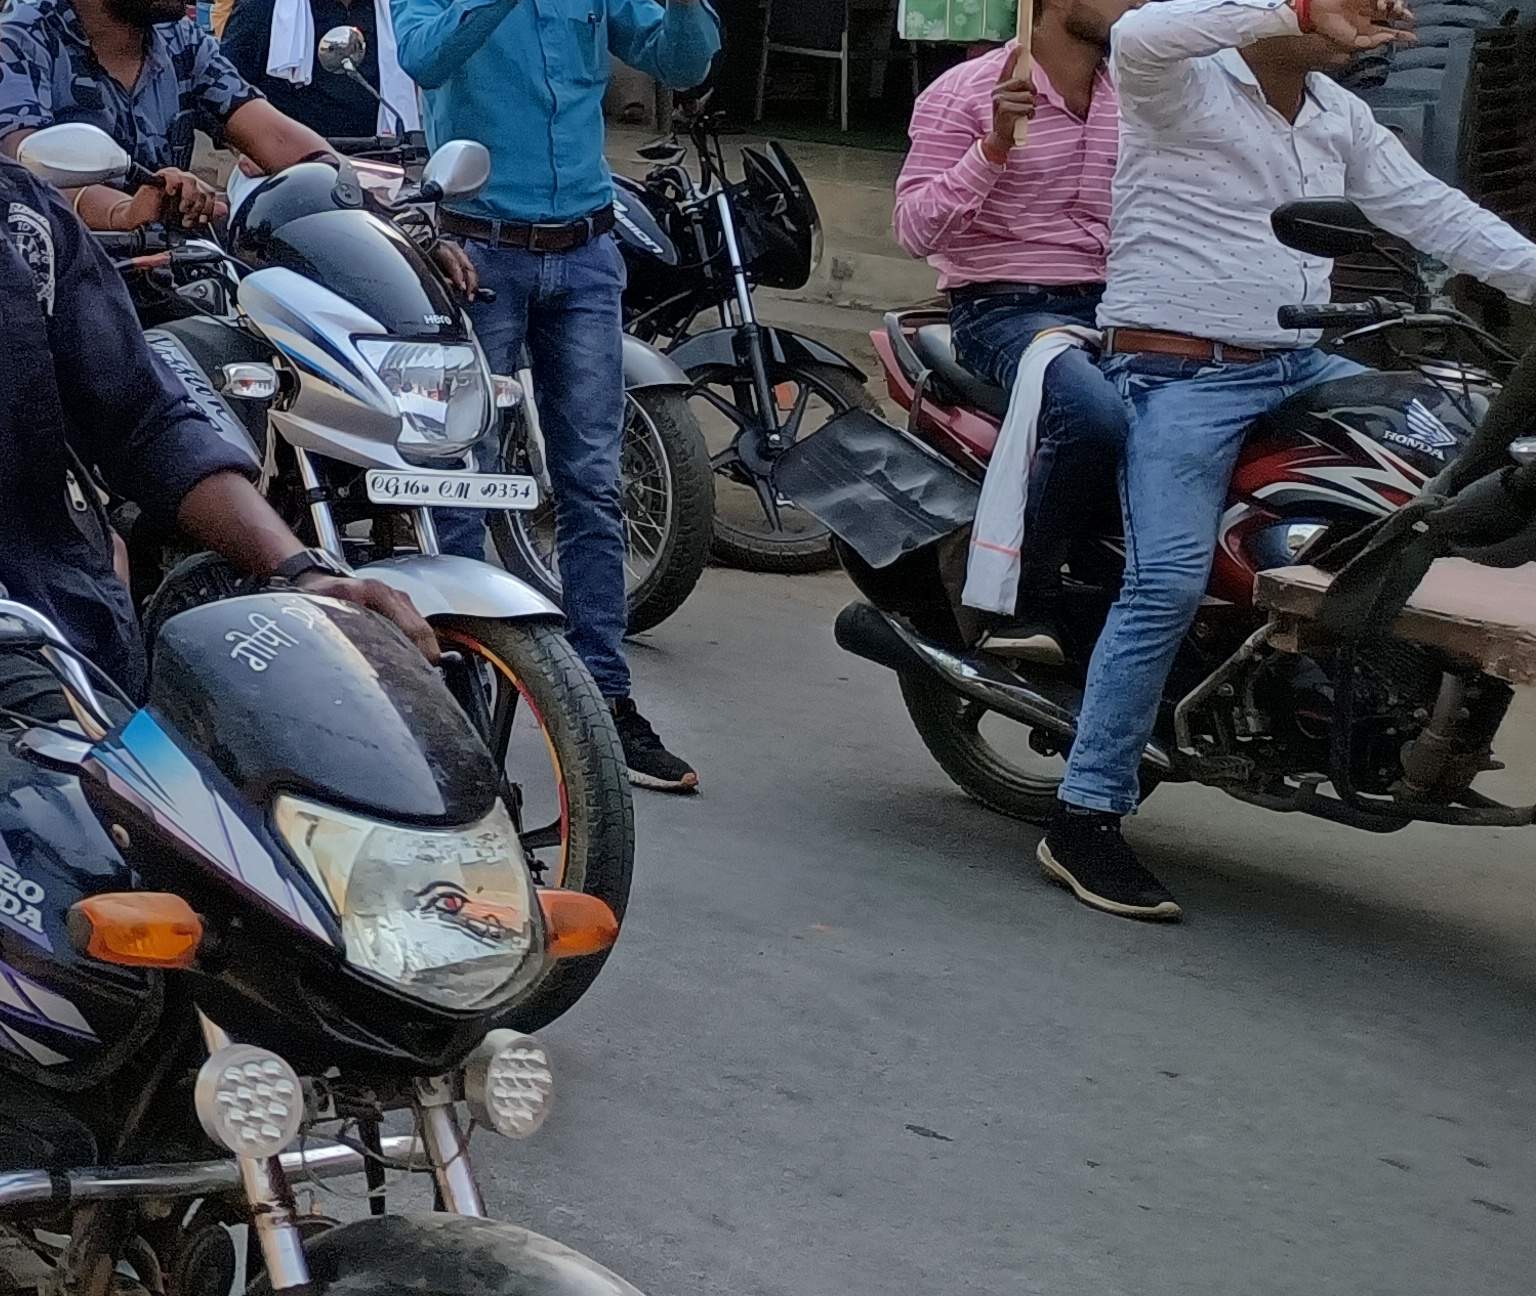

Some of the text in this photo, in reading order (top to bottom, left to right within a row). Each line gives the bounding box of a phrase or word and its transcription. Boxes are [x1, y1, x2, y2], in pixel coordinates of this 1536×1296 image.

[424, 312, 453, 326] Hero
[1383, 430, 1446, 461] HONDA
[225, 612, 300, 672] गोपी
